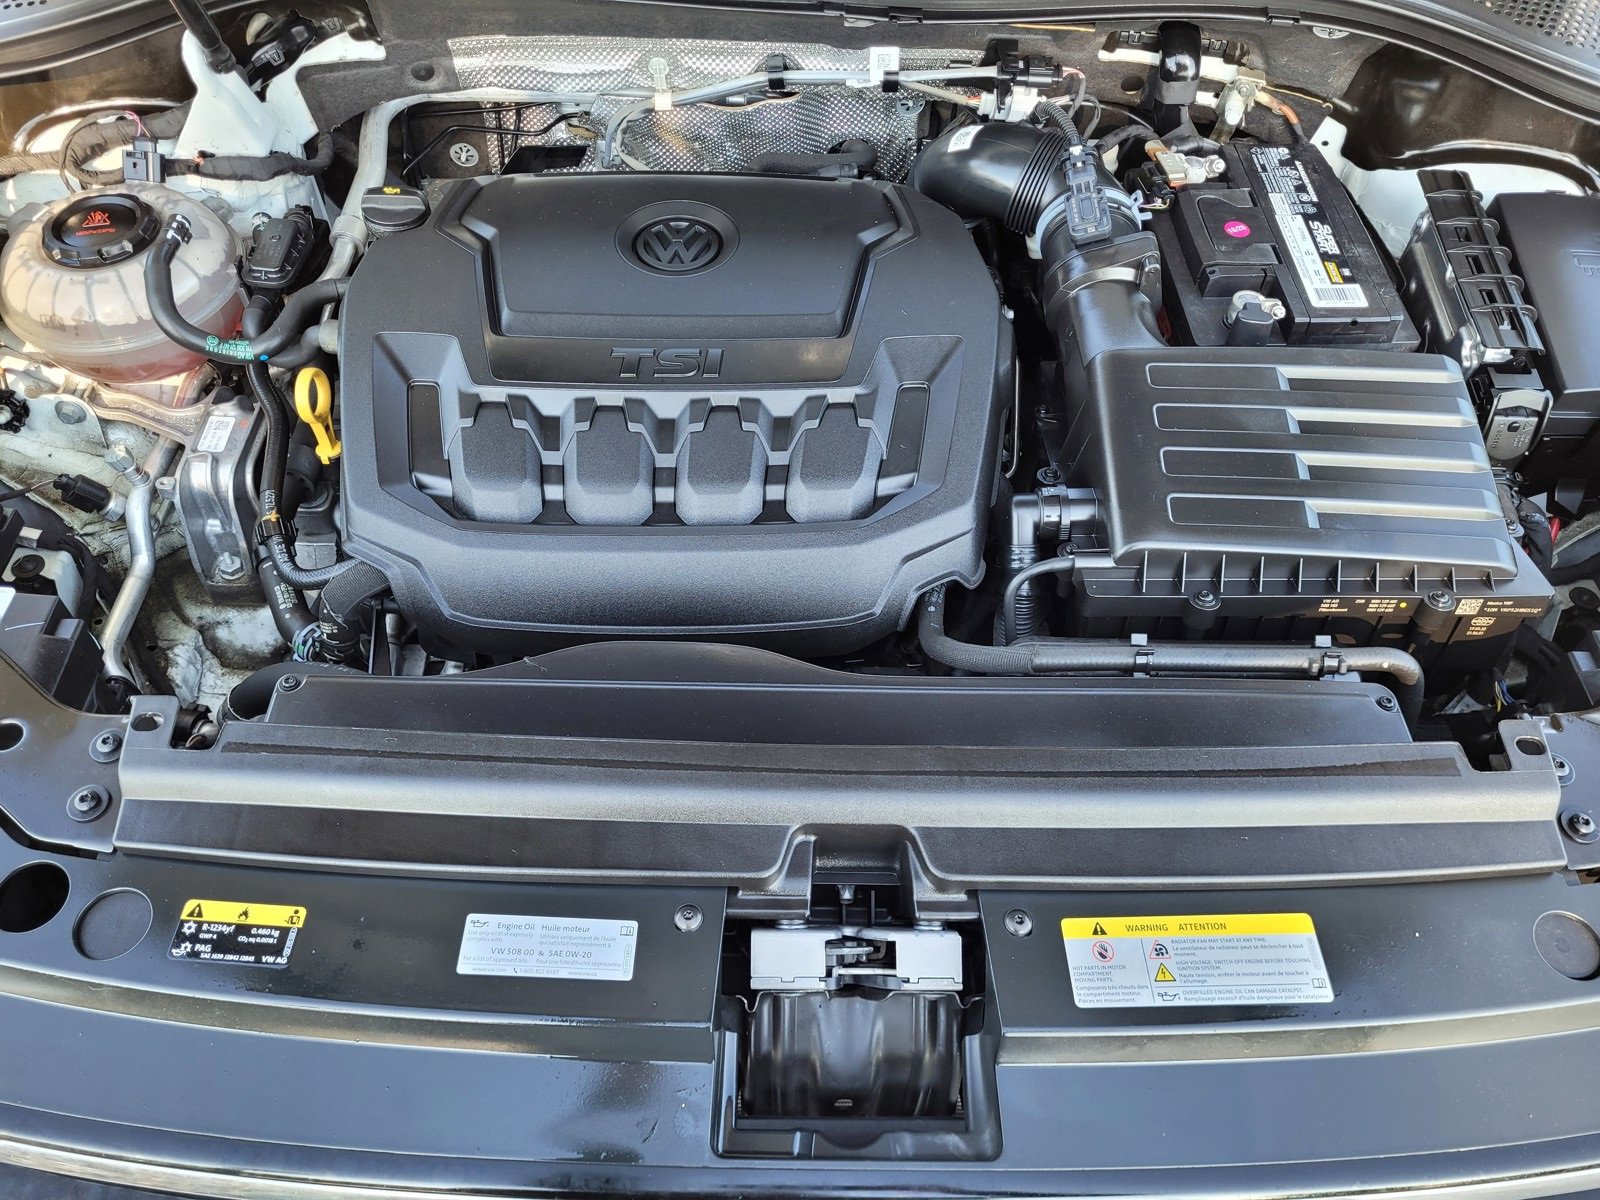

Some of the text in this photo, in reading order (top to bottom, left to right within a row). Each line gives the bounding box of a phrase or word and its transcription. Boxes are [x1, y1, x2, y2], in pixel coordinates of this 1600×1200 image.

[1308, 220, 1327, 254] START
[640, 220, 716, 268] VW
[611, 348, 724, 378] TSI
[202, 924, 235, 933] R-1234yf
[497, 922, 522, 931] Engine
[1125, 924, 1168, 932] WARNING
[271, 929, 280, 937] kg
